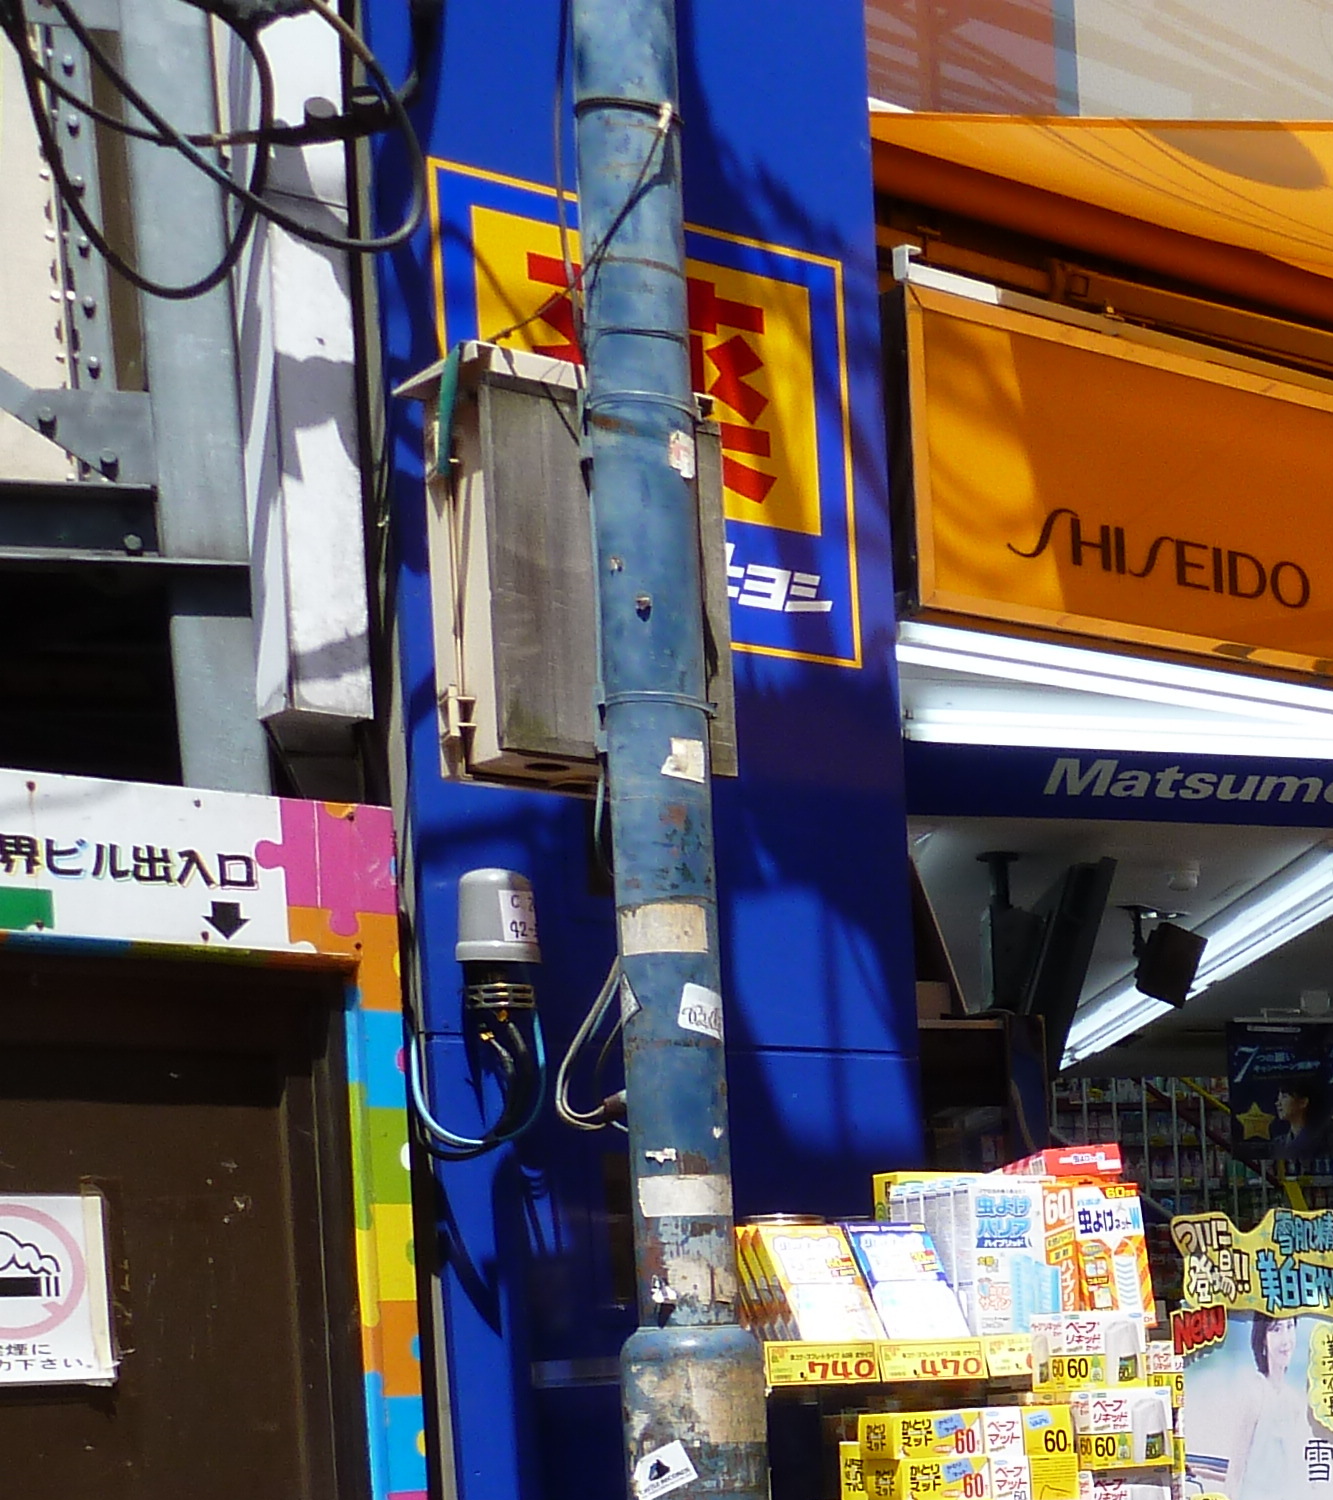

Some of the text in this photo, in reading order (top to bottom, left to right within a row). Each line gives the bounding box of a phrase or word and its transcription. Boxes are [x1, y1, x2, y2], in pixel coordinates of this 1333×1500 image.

[1007, 507, 1310, 609] SHISEIDO
[806, 1356, 875, 1381] 740
[920, 1356, 985, 1378] 470
[1067, 1356, 1089, 1379] 60
[1044, 1429, 1068, 1453] 60
[1094, 1437, 1116, 1457] 60
